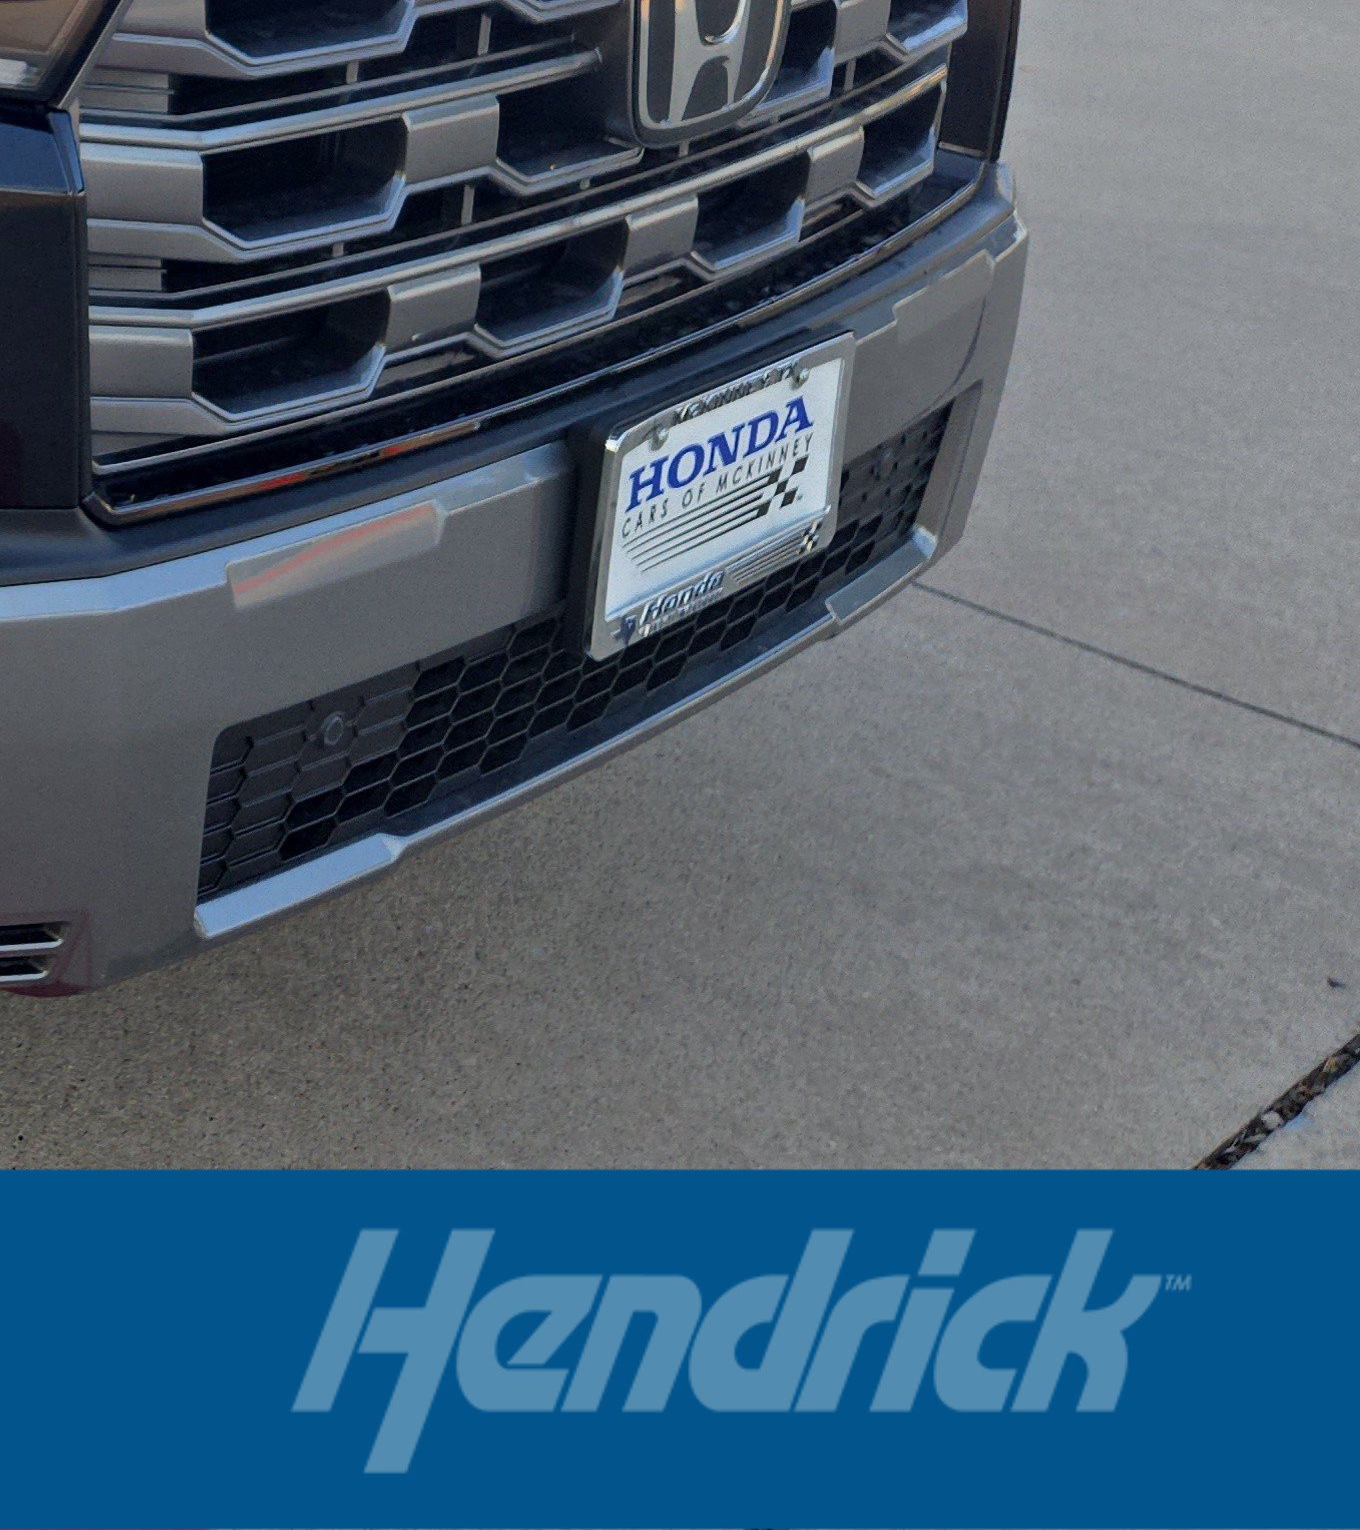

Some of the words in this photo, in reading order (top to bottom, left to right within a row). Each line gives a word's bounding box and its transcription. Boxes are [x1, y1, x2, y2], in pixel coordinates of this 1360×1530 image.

[622, 498, 669, 538] CARS
[681, 482, 706, 509] OF
[716, 432, 814, 494] MCKINNEY
[625, 396, 814, 513] HONDA
